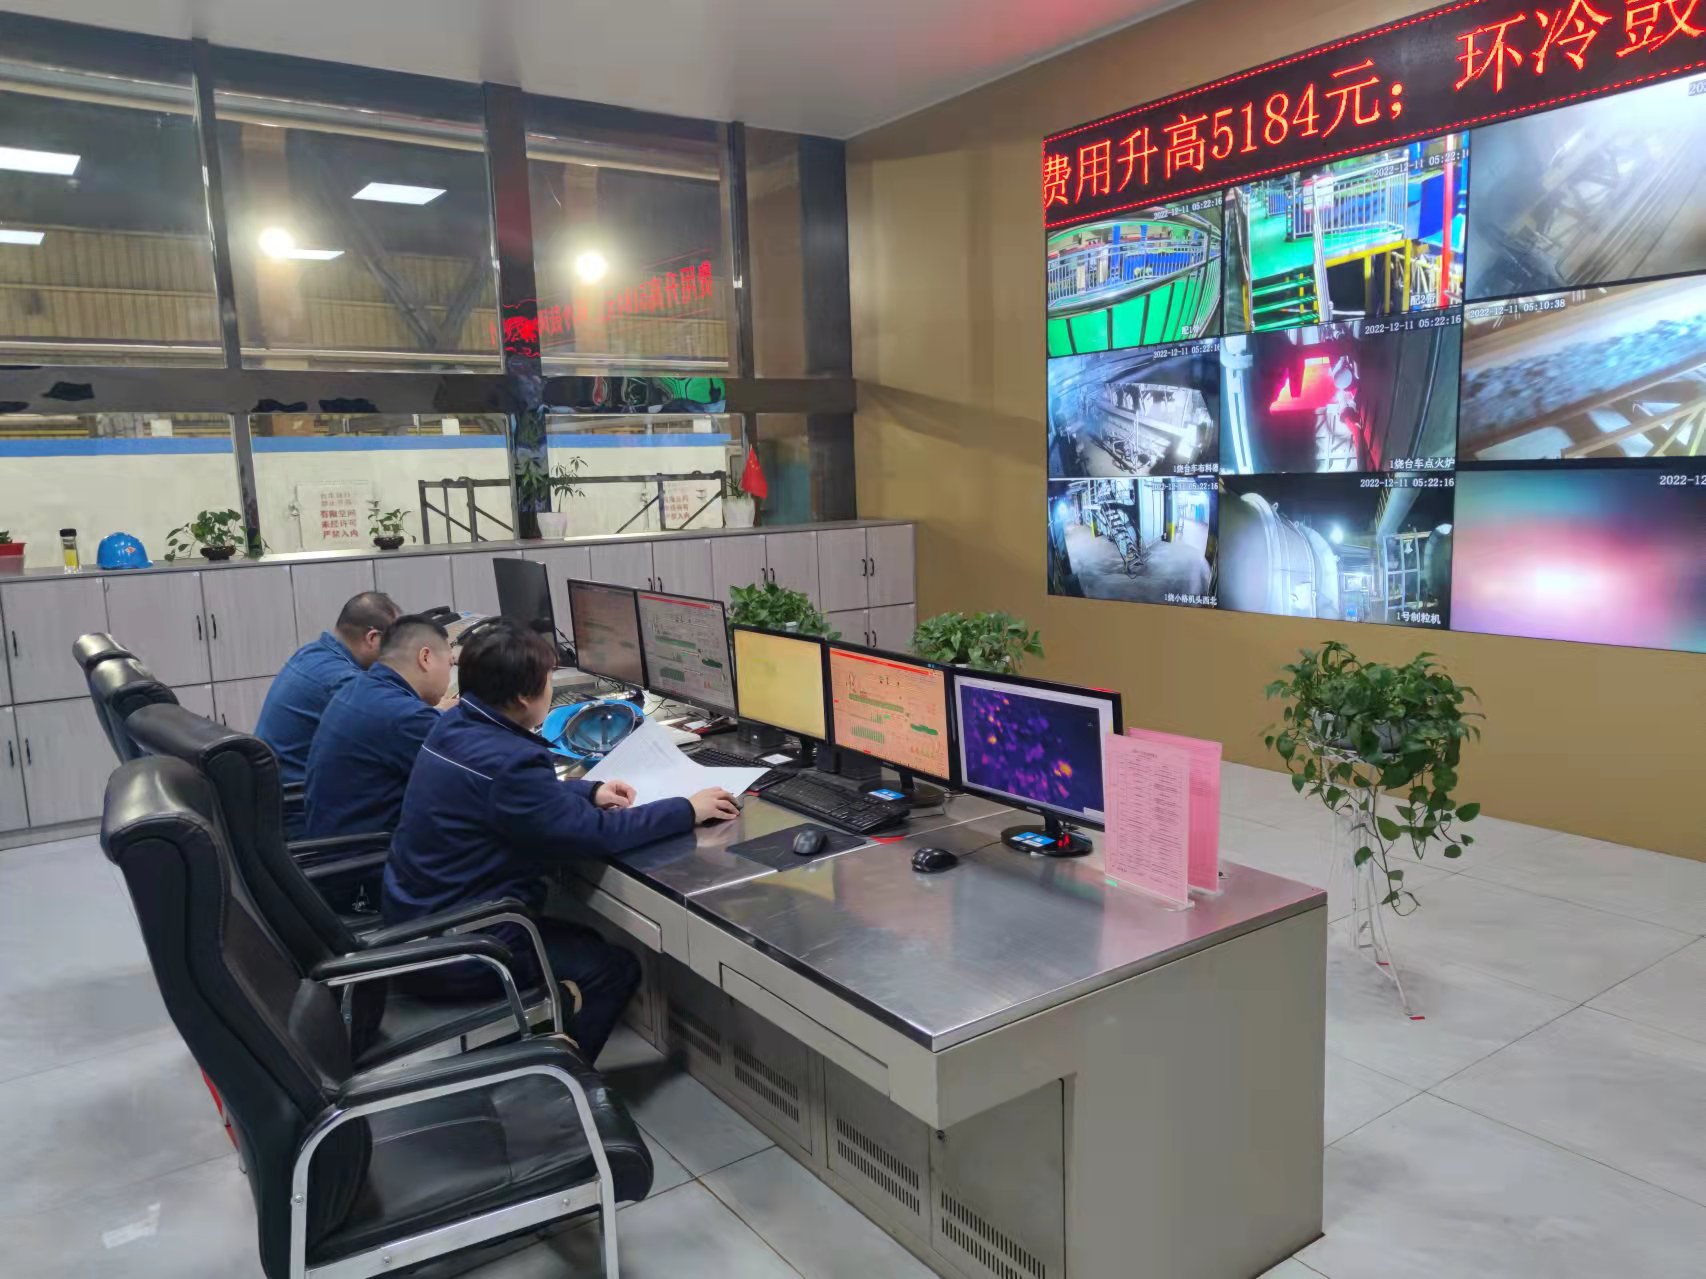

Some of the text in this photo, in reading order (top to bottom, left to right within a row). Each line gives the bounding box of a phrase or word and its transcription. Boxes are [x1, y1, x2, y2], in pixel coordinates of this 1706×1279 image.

[1455, 0, 1706, 94] 环冷鼓
[1374, 159, 1424, 178] 2022-12-11
[1191, 196, 1223, 212] 05:22:16
[1469, 298, 1566, 318] 2022-12-11 05:10:38
[1364, 314, 1462, 335] 2022-12-11 05:22:16
[1153, 347, 1188, 360] 2022-12-11
[1389, 457, 1455, 470] 1烧台车点火炉
[1360, 477, 1455, 488] 2022-12-11 05:22:16
[1396, 611, 1442, 625] 1号制粒机
